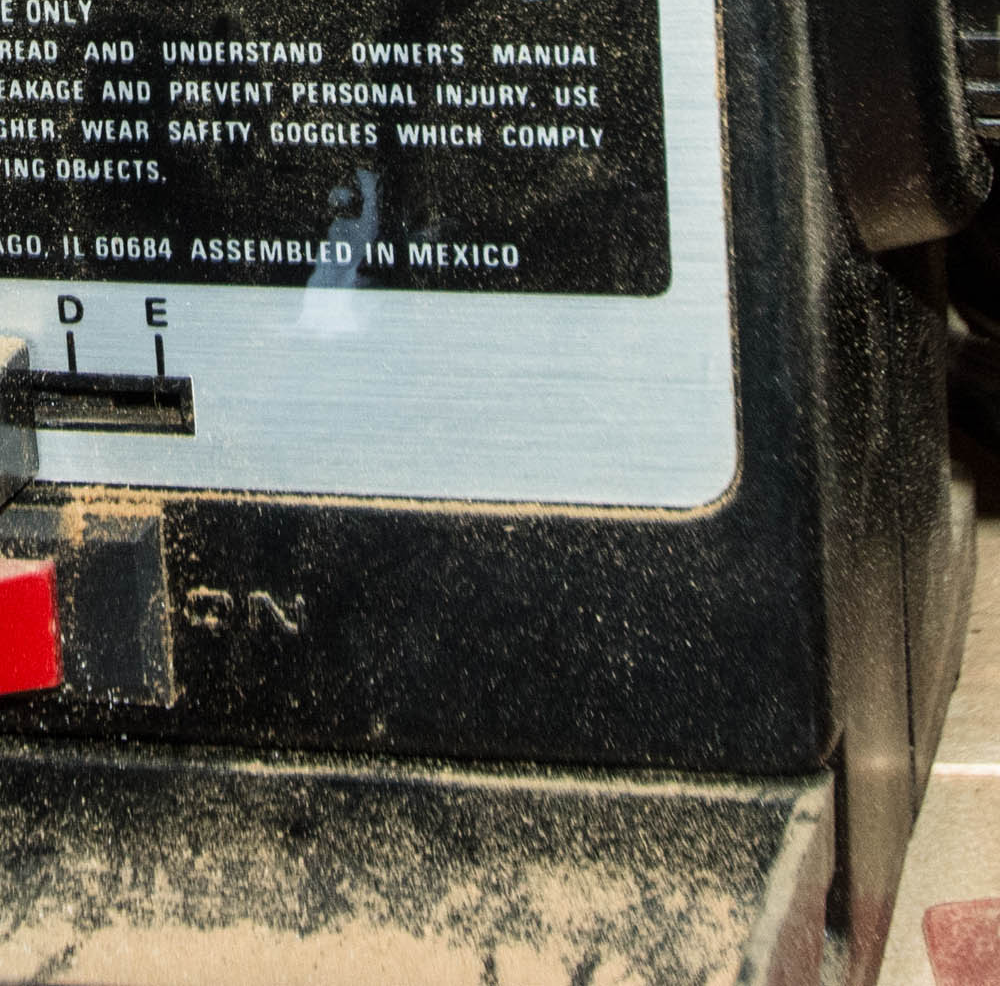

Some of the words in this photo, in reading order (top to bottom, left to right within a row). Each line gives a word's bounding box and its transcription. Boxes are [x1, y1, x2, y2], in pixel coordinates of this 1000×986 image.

[26, 0, 92, 26] ONLY
[0, 40, 58, 62] READ
[85, 41, 135, 63] AND
[163, 41, 323, 66] UNDERSTAND
[352, 43, 465, 65] OWNER'S
[493, 45, 598, 67] MANUAL
[102, 81, 151, 103] AND
[169, 81, 274, 104] PREVENT
[292, 82, 416, 106] PERSONAL
[436, 84, 536, 108] INJURY.
[555, 86, 600, 108] USE
[81, 120, 149, 142] WEAR
[169, 121, 252, 144] SAFETY
[270, 122, 378, 146] GOGGLES
[397, 124, 483, 147] WHICH
[503, 125, 603, 148] COMPLY
[56, 159, 168, 183] OBJECTS.
[63, 235, 85, 261] IL
[95, 236, 172, 262] 60684
[191, 238, 352, 267] ASSEMBLED
[365, 242, 395, 267] IN
[408, 242, 519, 270] MEXICO
[57, 294, 84, 325] D
[145, 297, 168, 327] E
